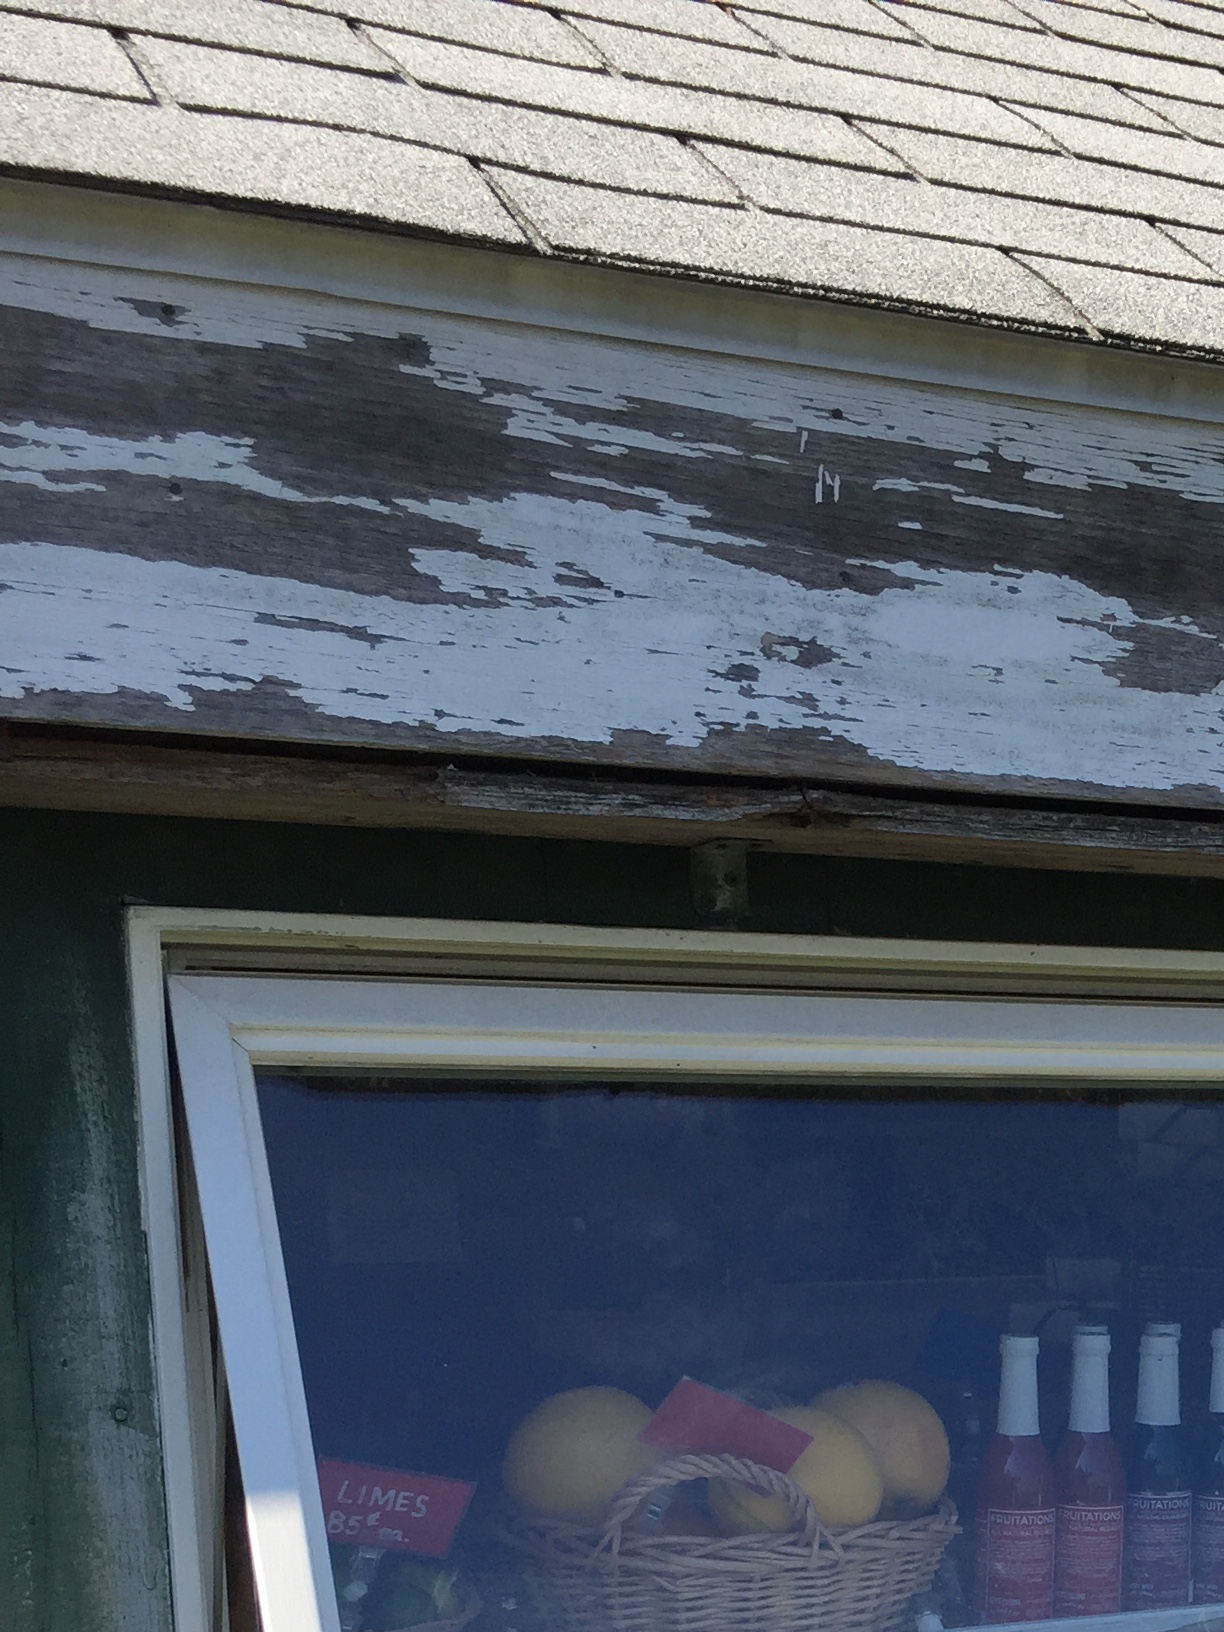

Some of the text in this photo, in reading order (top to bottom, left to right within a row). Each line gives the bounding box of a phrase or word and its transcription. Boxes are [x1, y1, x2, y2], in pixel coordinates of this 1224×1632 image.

[337, 1479, 430, 1518] LIMES
[991, 1513, 1054, 1525] FRUITATIONS
[1058, 1508, 1121, 1521] FRUITATIONS
